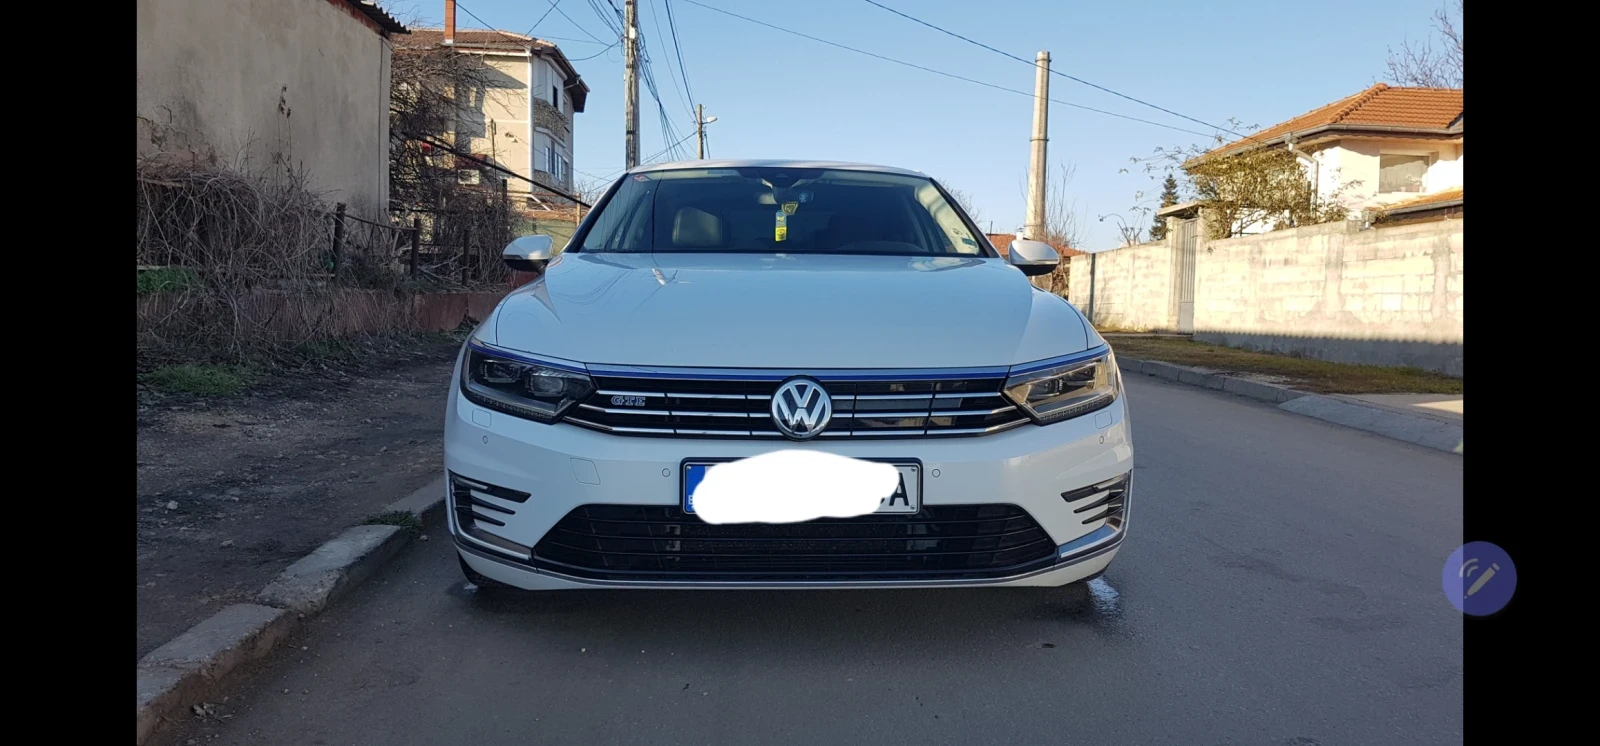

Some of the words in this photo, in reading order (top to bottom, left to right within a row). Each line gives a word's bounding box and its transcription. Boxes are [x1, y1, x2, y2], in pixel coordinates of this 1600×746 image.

[611, 395, 646, 407] GTE
[774, 381, 830, 436] VW
[880, 472, 909, 506] A
